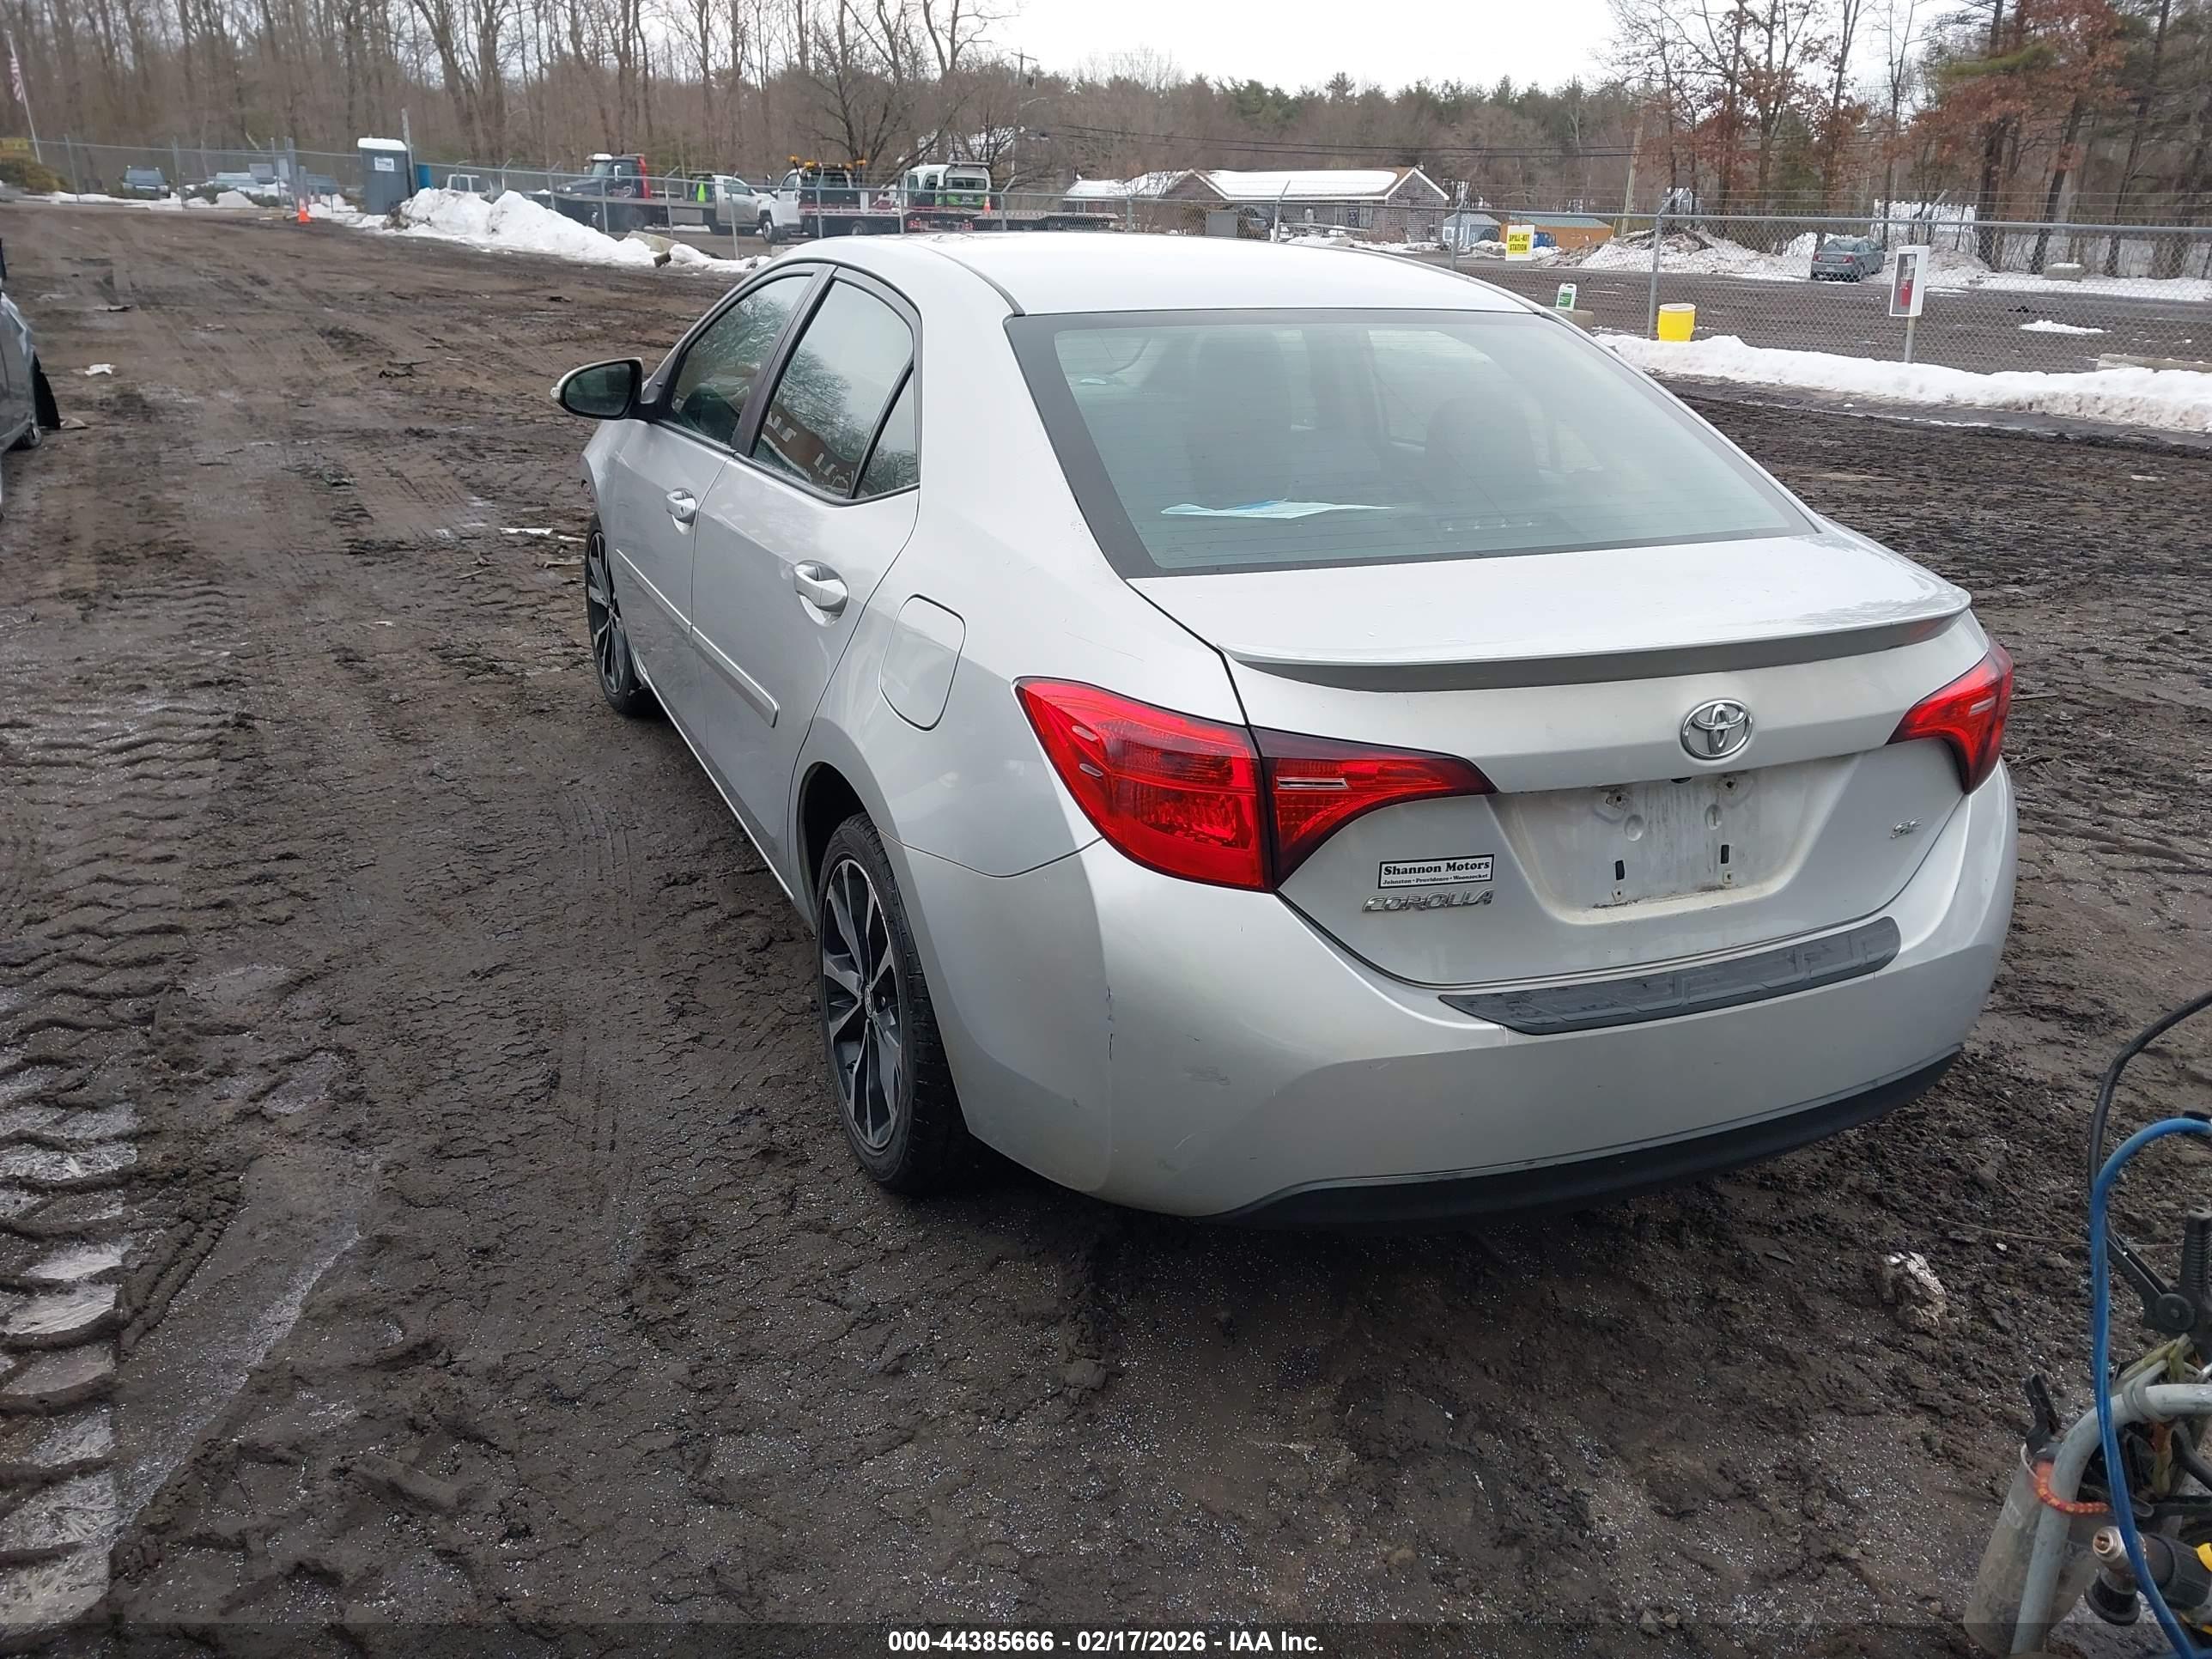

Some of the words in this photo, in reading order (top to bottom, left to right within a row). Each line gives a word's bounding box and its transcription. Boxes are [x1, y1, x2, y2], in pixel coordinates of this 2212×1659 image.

[1383, 865, 1442, 876] Shannon
[1445, 860, 1490, 872] Motors
[1362, 888, 1496, 913] COROLLA
